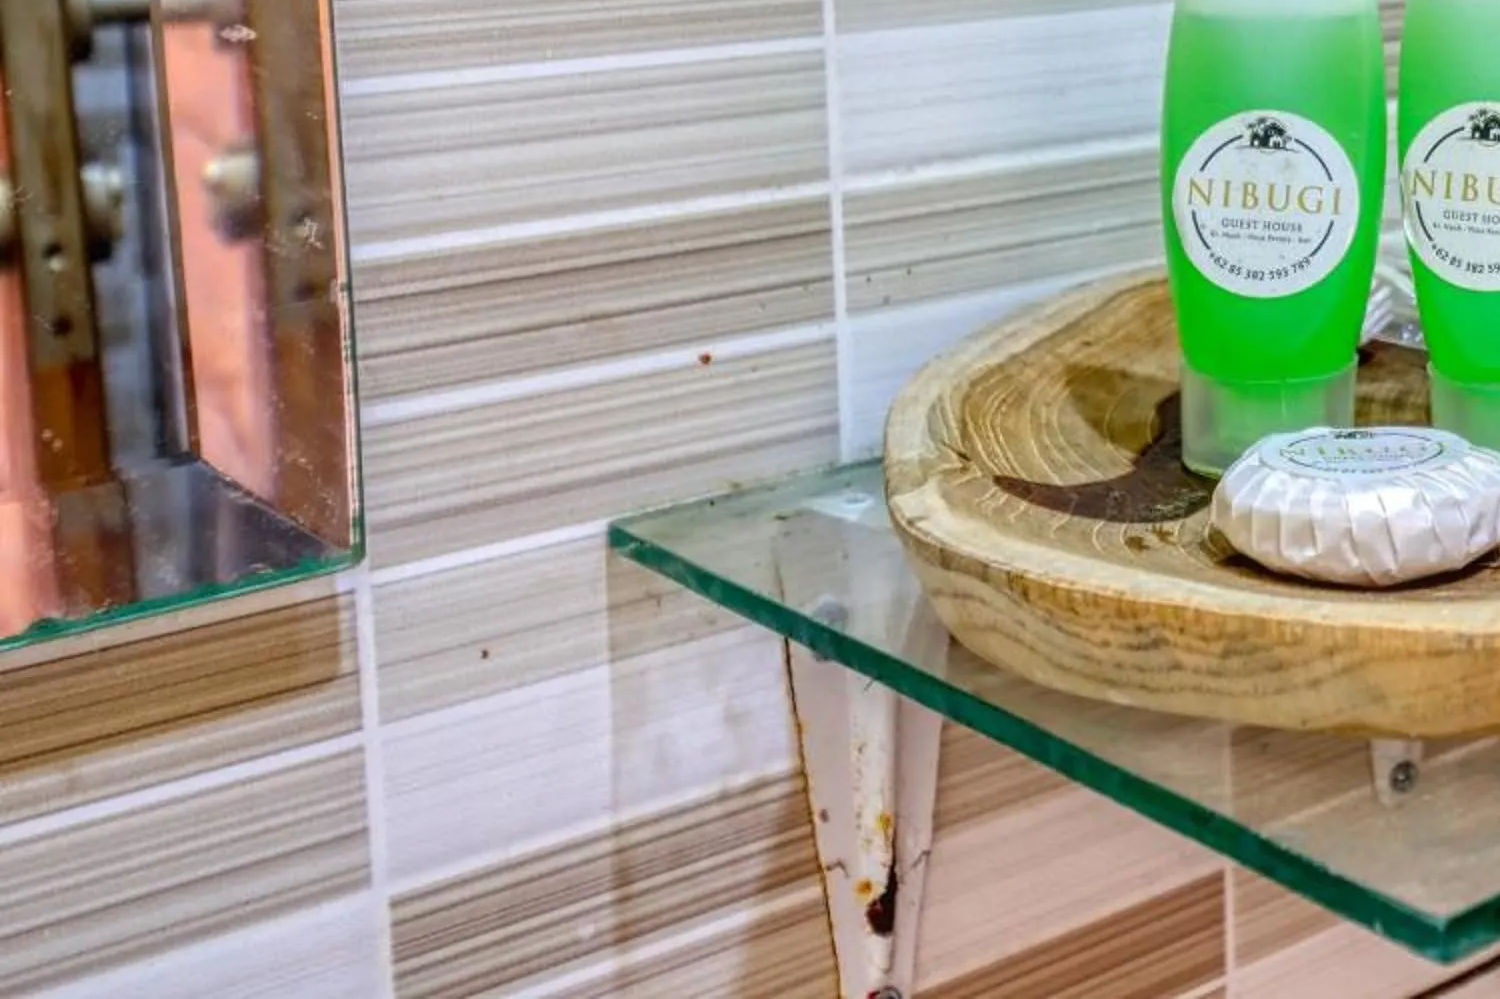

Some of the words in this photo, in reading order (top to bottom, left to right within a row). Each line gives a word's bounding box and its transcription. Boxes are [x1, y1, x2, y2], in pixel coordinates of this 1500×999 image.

[1187, 177, 1342, 216] NIBUGI
[1443, 209, 1479, 222] GUEST
[1221, 217, 1260, 230] GUEST
[1263, 220, 1302, 233] HOUSE
